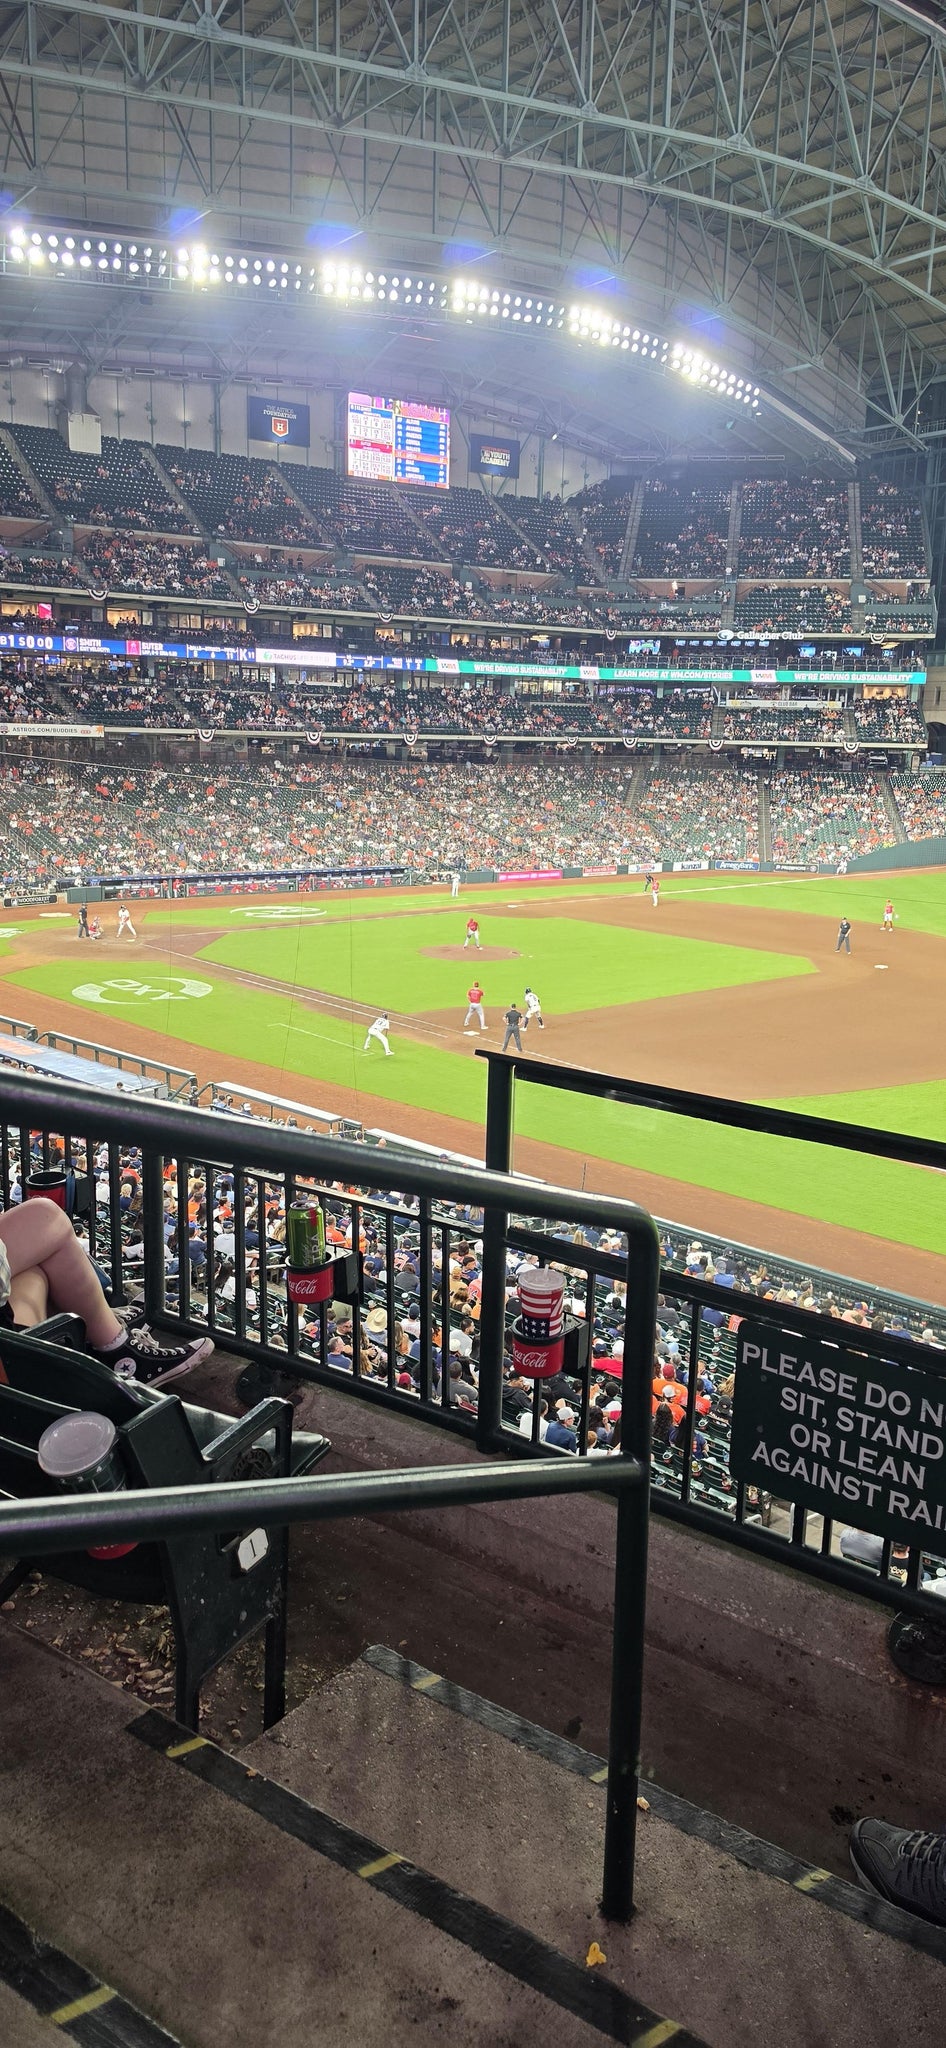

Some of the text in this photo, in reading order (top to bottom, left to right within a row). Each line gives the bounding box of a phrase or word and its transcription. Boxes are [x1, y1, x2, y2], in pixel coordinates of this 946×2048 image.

[263, 409, 297, 420] FOUNDATION
[491, 450, 511, 460] YOUTH
[480, 456, 510, 467] ACADEMY
[736, 631, 804, 641] Gallagher Club
[79, 637, 102, 647] SMITH
[141, 641, 164, 651] SUTER
[240, 648, 247, 660] K
[273, 653, 297, 661] TACHUS
[494, 664, 519, 673] DRIVING
[614, 670, 637, 678] LEARN
[638, 670, 659, 678] MORE
[793, 672, 818, 680] WE'RE
[819, 673, 850, 681] DRIVING
[742, 1341, 946, 1428] PLEASE DO N
[780, 1387, 944, 1461] SIT, STAND
[789, 1423, 926, 1490] OR LEAN
[751, 1440, 946, 1532] AGAINST RAI
